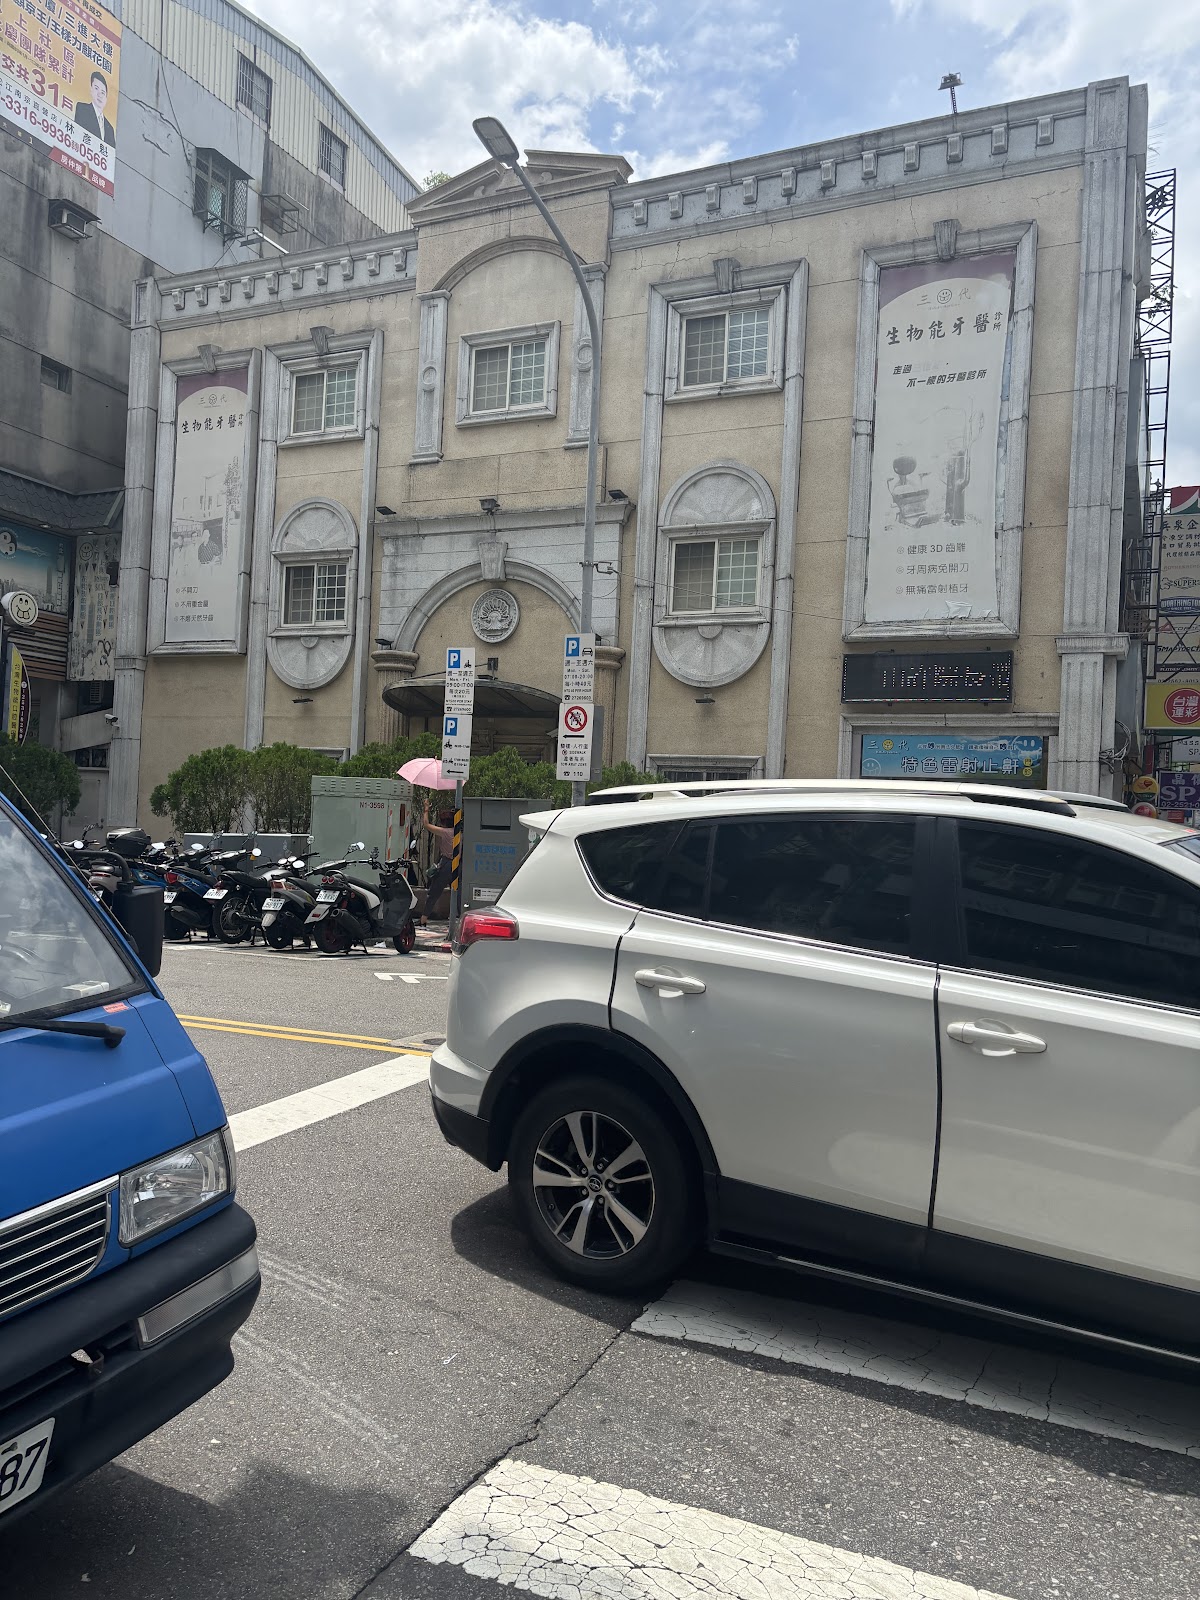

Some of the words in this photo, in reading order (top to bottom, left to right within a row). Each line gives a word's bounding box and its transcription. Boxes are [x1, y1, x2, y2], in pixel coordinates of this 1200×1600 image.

[885, 313, 990, 346] 生物能牙醫
[181, 414, 236, 434] 生物能牙醫
[907, 545, 927, 555] 健康
[930, 544, 943, 553] 3D
[906, 563, 969, 575] 牙周病免開刀
[1173, 696, 1199, 706] 台灣
[1171, 706, 1199, 718] 運彩
[901, 756, 1020, 775] 特色雷射止鼾
[1161, 785, 1200, 801] SP
[0, 1436, 48, 1500] 87
